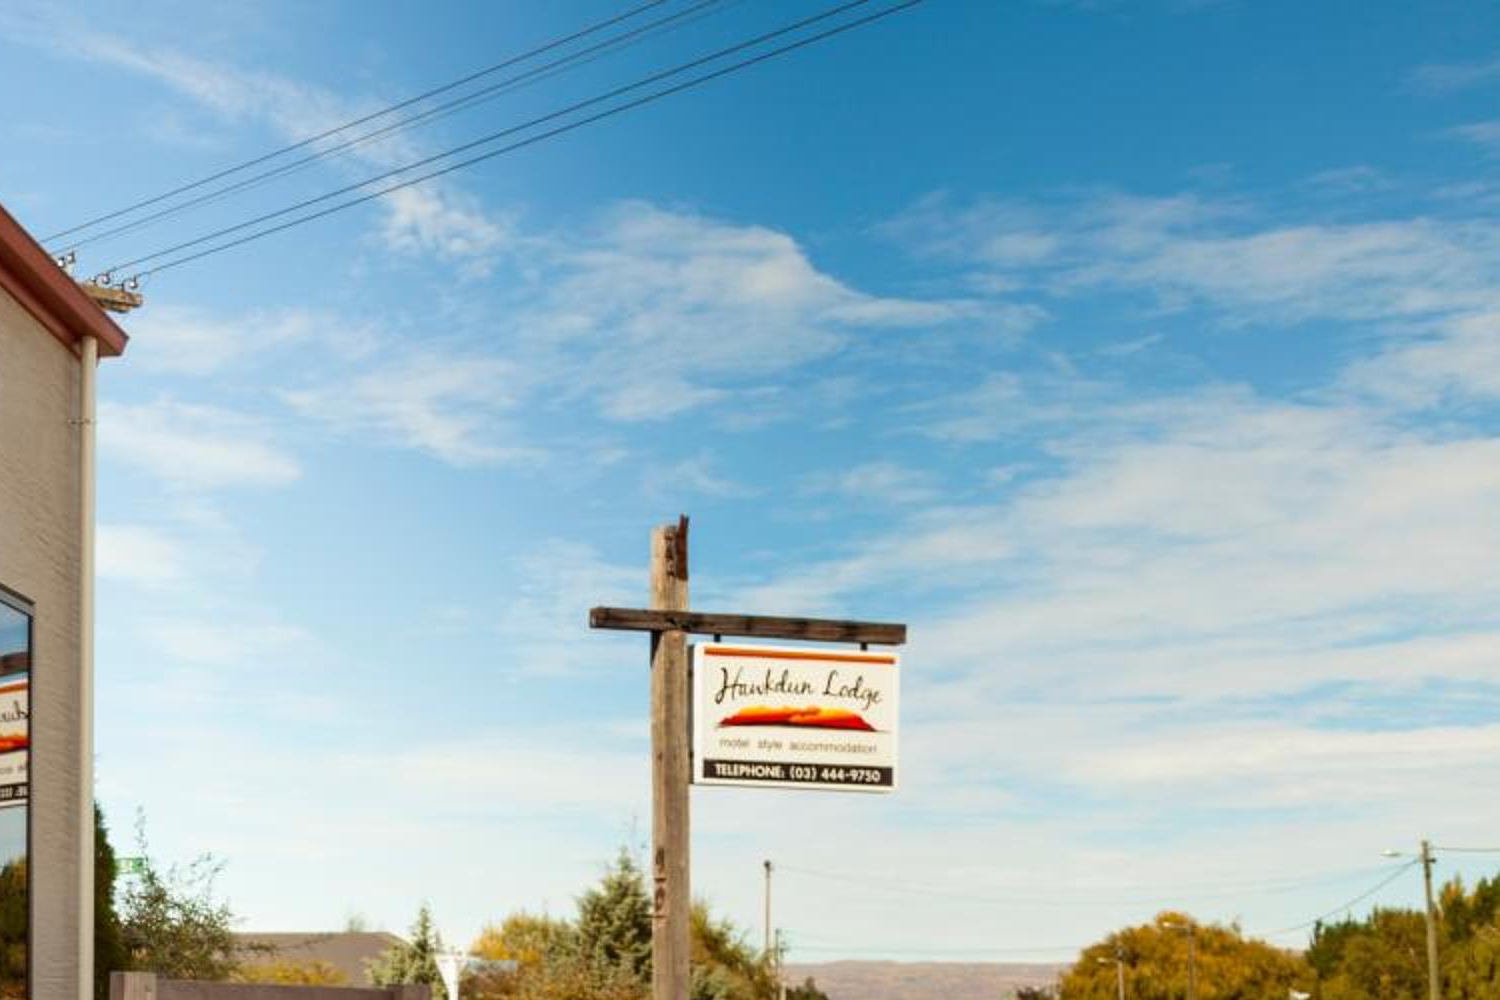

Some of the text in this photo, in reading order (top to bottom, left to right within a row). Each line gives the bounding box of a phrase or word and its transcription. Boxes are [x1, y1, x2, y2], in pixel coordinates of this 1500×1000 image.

[715, 666, 883, 710] Hawkdun Lodge
[757, 740, 782, 752] style
[789, 740, 876, 753] accommodation
[715, 763, 881, 783] TELEPHONE: (03) 444-9750
